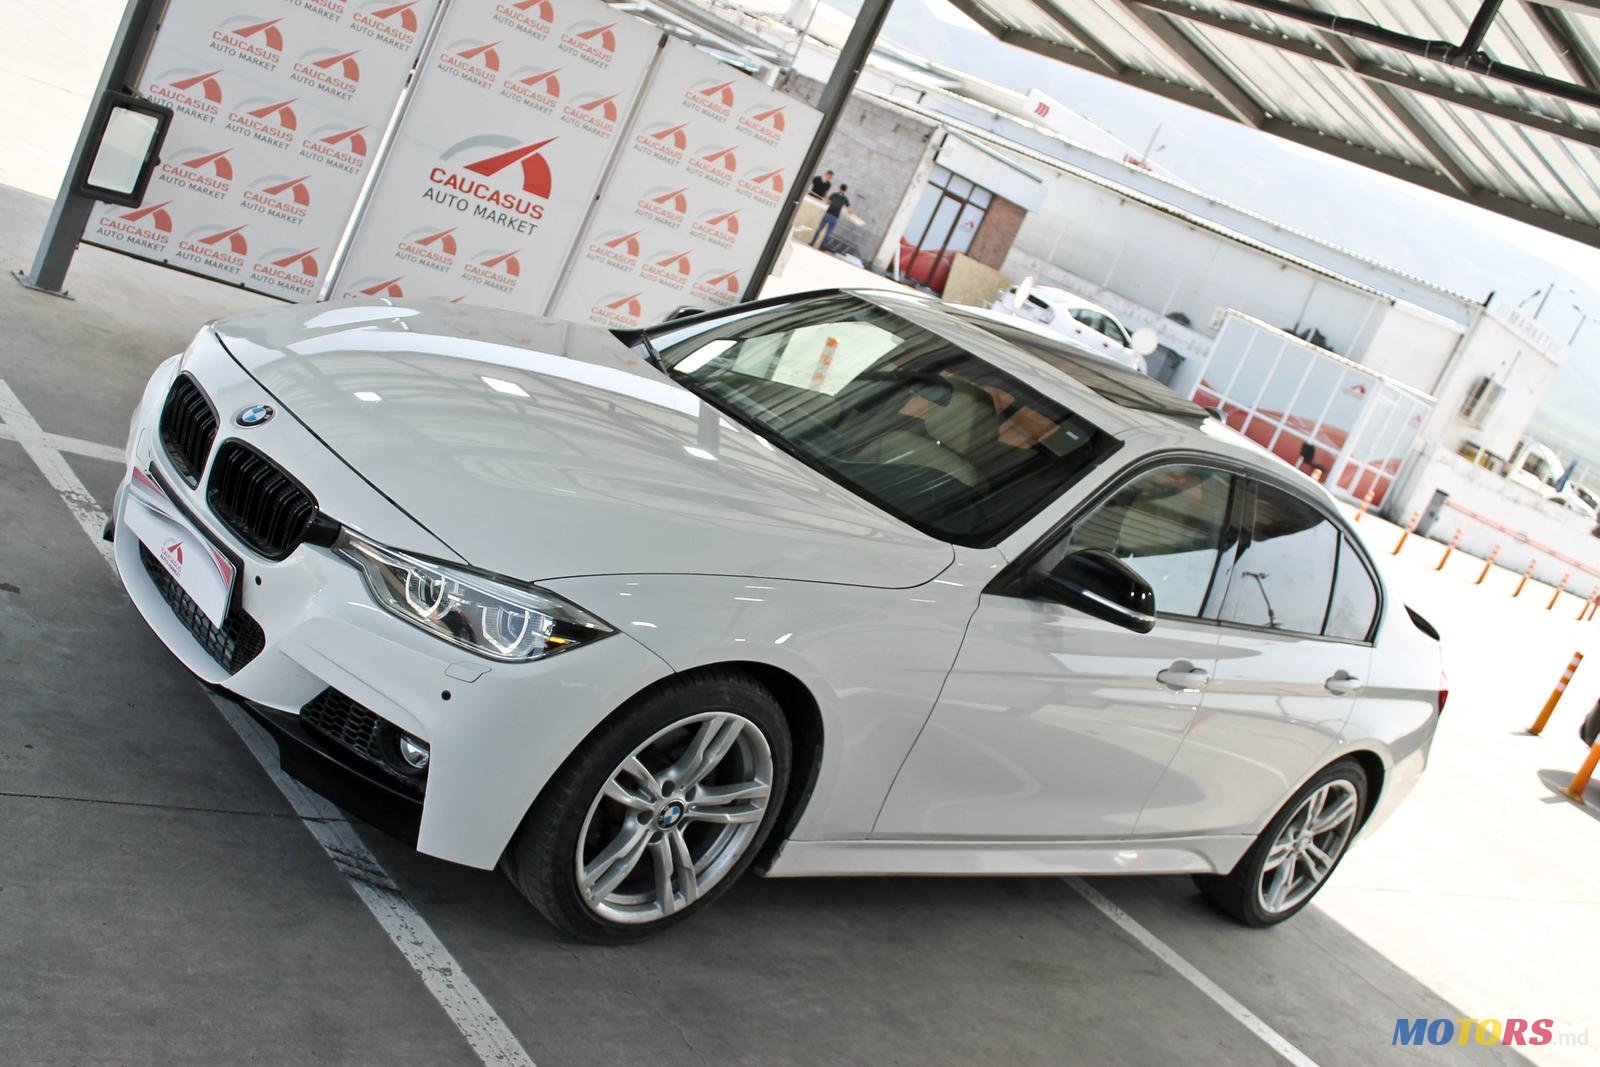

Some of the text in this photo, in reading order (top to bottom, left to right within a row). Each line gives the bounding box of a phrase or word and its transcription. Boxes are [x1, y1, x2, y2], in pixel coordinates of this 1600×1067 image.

[304, 2, 340, 22] MARKET
[496, 4, 550, 33] CAUCASUS
[350, 23, 411, 52] AUTO MARKET
[353, 12, 415, 44] CAUCASUS
[493, 14, 547, 41] AUTO MARKET
[210, 42, 276, 71] AUTO MARKET
[213, 31, 280, 63] CAUCASUS
[558, 44, 609, 71] AUTO MARKET
[561, 33, 612, 63] CAUCASUS
[294, 63, 356, 93] CAUCASUS
[437, 63, 492, 90] AUTO MARKET
[440, 53, 495, 82] CAUCASUS
[150, 85, 219, 115] CAUCASUS
[291, 73, 353, 101] AUTO MARKET
[504, 80, 556, 108] CAUCASUS
[147, 96, 215, 123] AUTO MARKET
[501, 90, 553, 116] AUTO MARKET
[685, 91, 730, 117] CAUCASUS
[229, 113, 294, 142] CAUCASUS
[561, 115, 610, 139] AUTO MARKET
[564, 106, 613, 132] CAUCASUS
[738, 116, 781, 141] CAUCASUS
[225, 123, 290, 150] AUTO MARKET
[637, 134, 683, 160] CAUCASUS
[300, 149, 359, 175] AUTO MARKET
[303, 140, 363, 167] CAUCASUS
[162, 164, 229, 192] CAUCASUS
[689, 158, 732, 182] CAUCASUS
[159, 174, 225, 199] AUTO MARKET
[429, 167, 544, 219] CAUCASUS
[738, 179, 780, 201] CAUCASUS
[240, 200, 303, 224] AUTO MARKET
[244, 191, 306, 217] CAUCASUS
[423, 188, 538, 236] AUTO MARKET
[638, 200, 684, 222] CAUCASUS
[96, 227, 164, 251] AUTO MARKET
[100, 217, 168, 244] CAUCASUS
[692, 221, 736, 244] CAUCASUS
[176, 250, 240, 273] AUTO MARKET
[179, 240, 244, 266] CAUCASUS
[396, 250, 450, 272] AUTO MARKET
[399, 242, 453, 266] CAUCASUS
[589, 244, 636, 266] CAUCASUS
[251, 272, 311, 294] AUTO MARKET
[254, 264, 315, 288] CAUCASUS
[462, 271, 513, 292] AUTO MARKET
[465, 263, 517, 286] CAUCASUS
[642, 264, 687, 285] CAUCASUS
